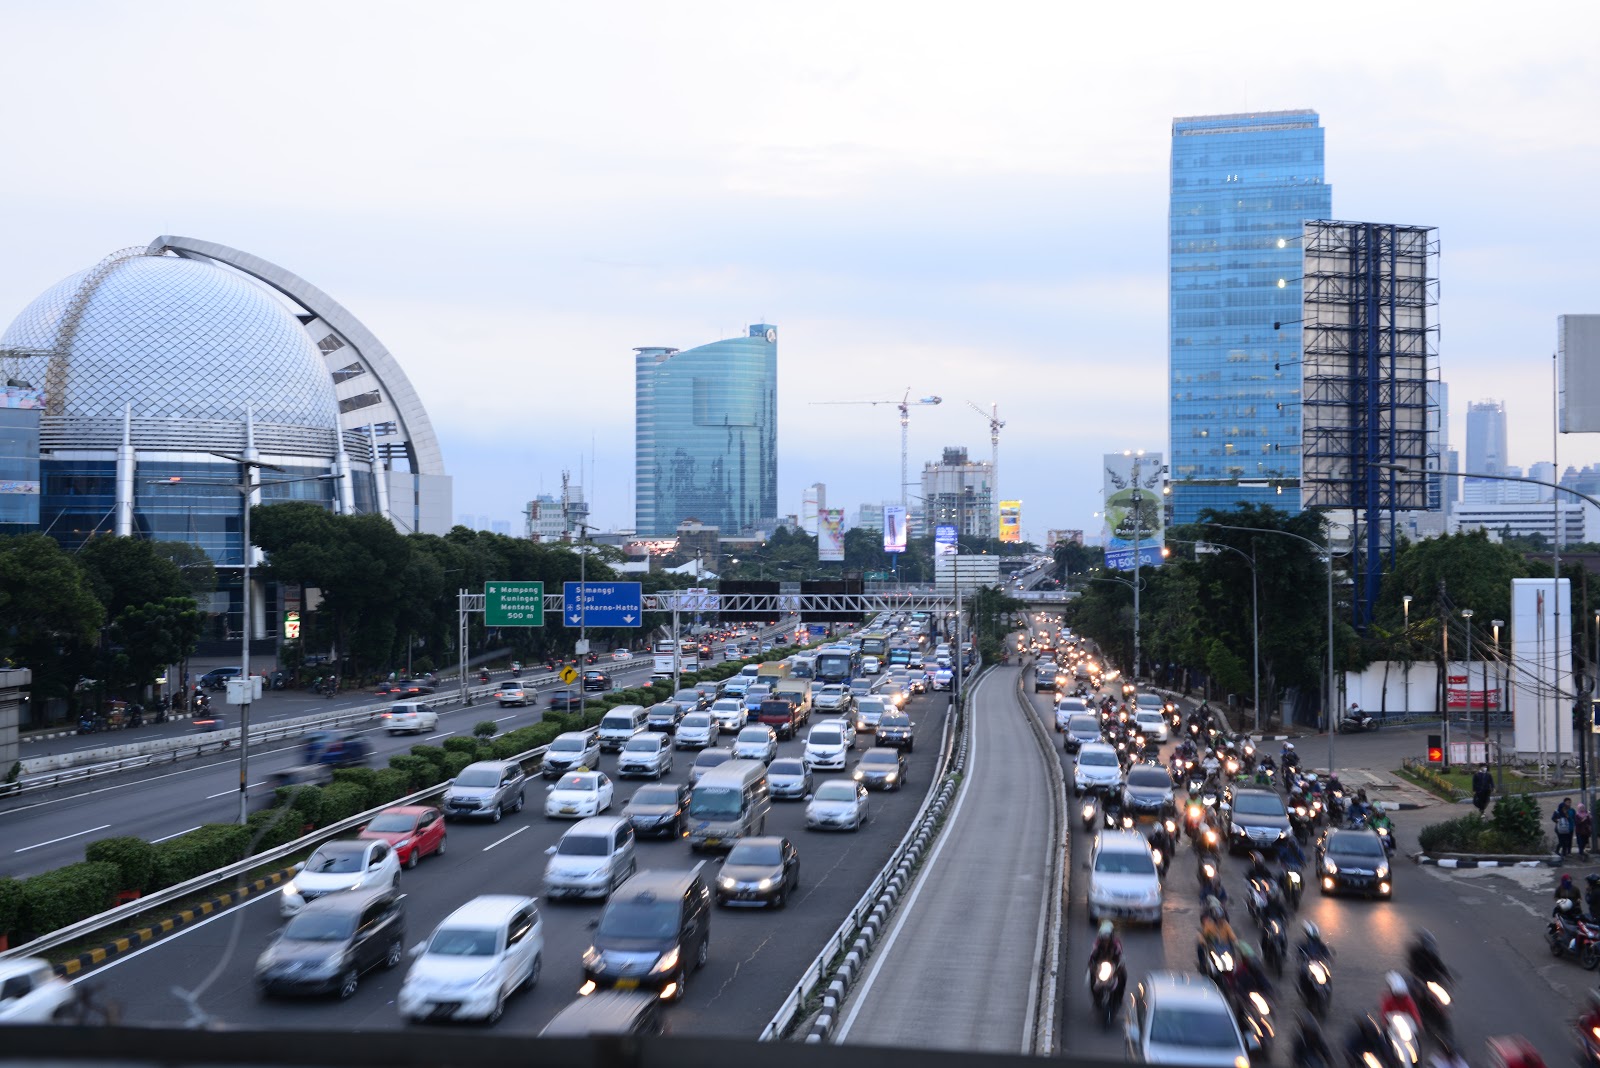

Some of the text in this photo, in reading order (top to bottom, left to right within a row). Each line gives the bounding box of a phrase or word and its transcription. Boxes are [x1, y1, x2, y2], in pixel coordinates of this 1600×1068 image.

[500, 586, 538, 594] Mampang
[500, 595, 539, 603] Kuningan
[575, 595, 595, 603] Sipi
[500, 603, 534, 611] Menteng
